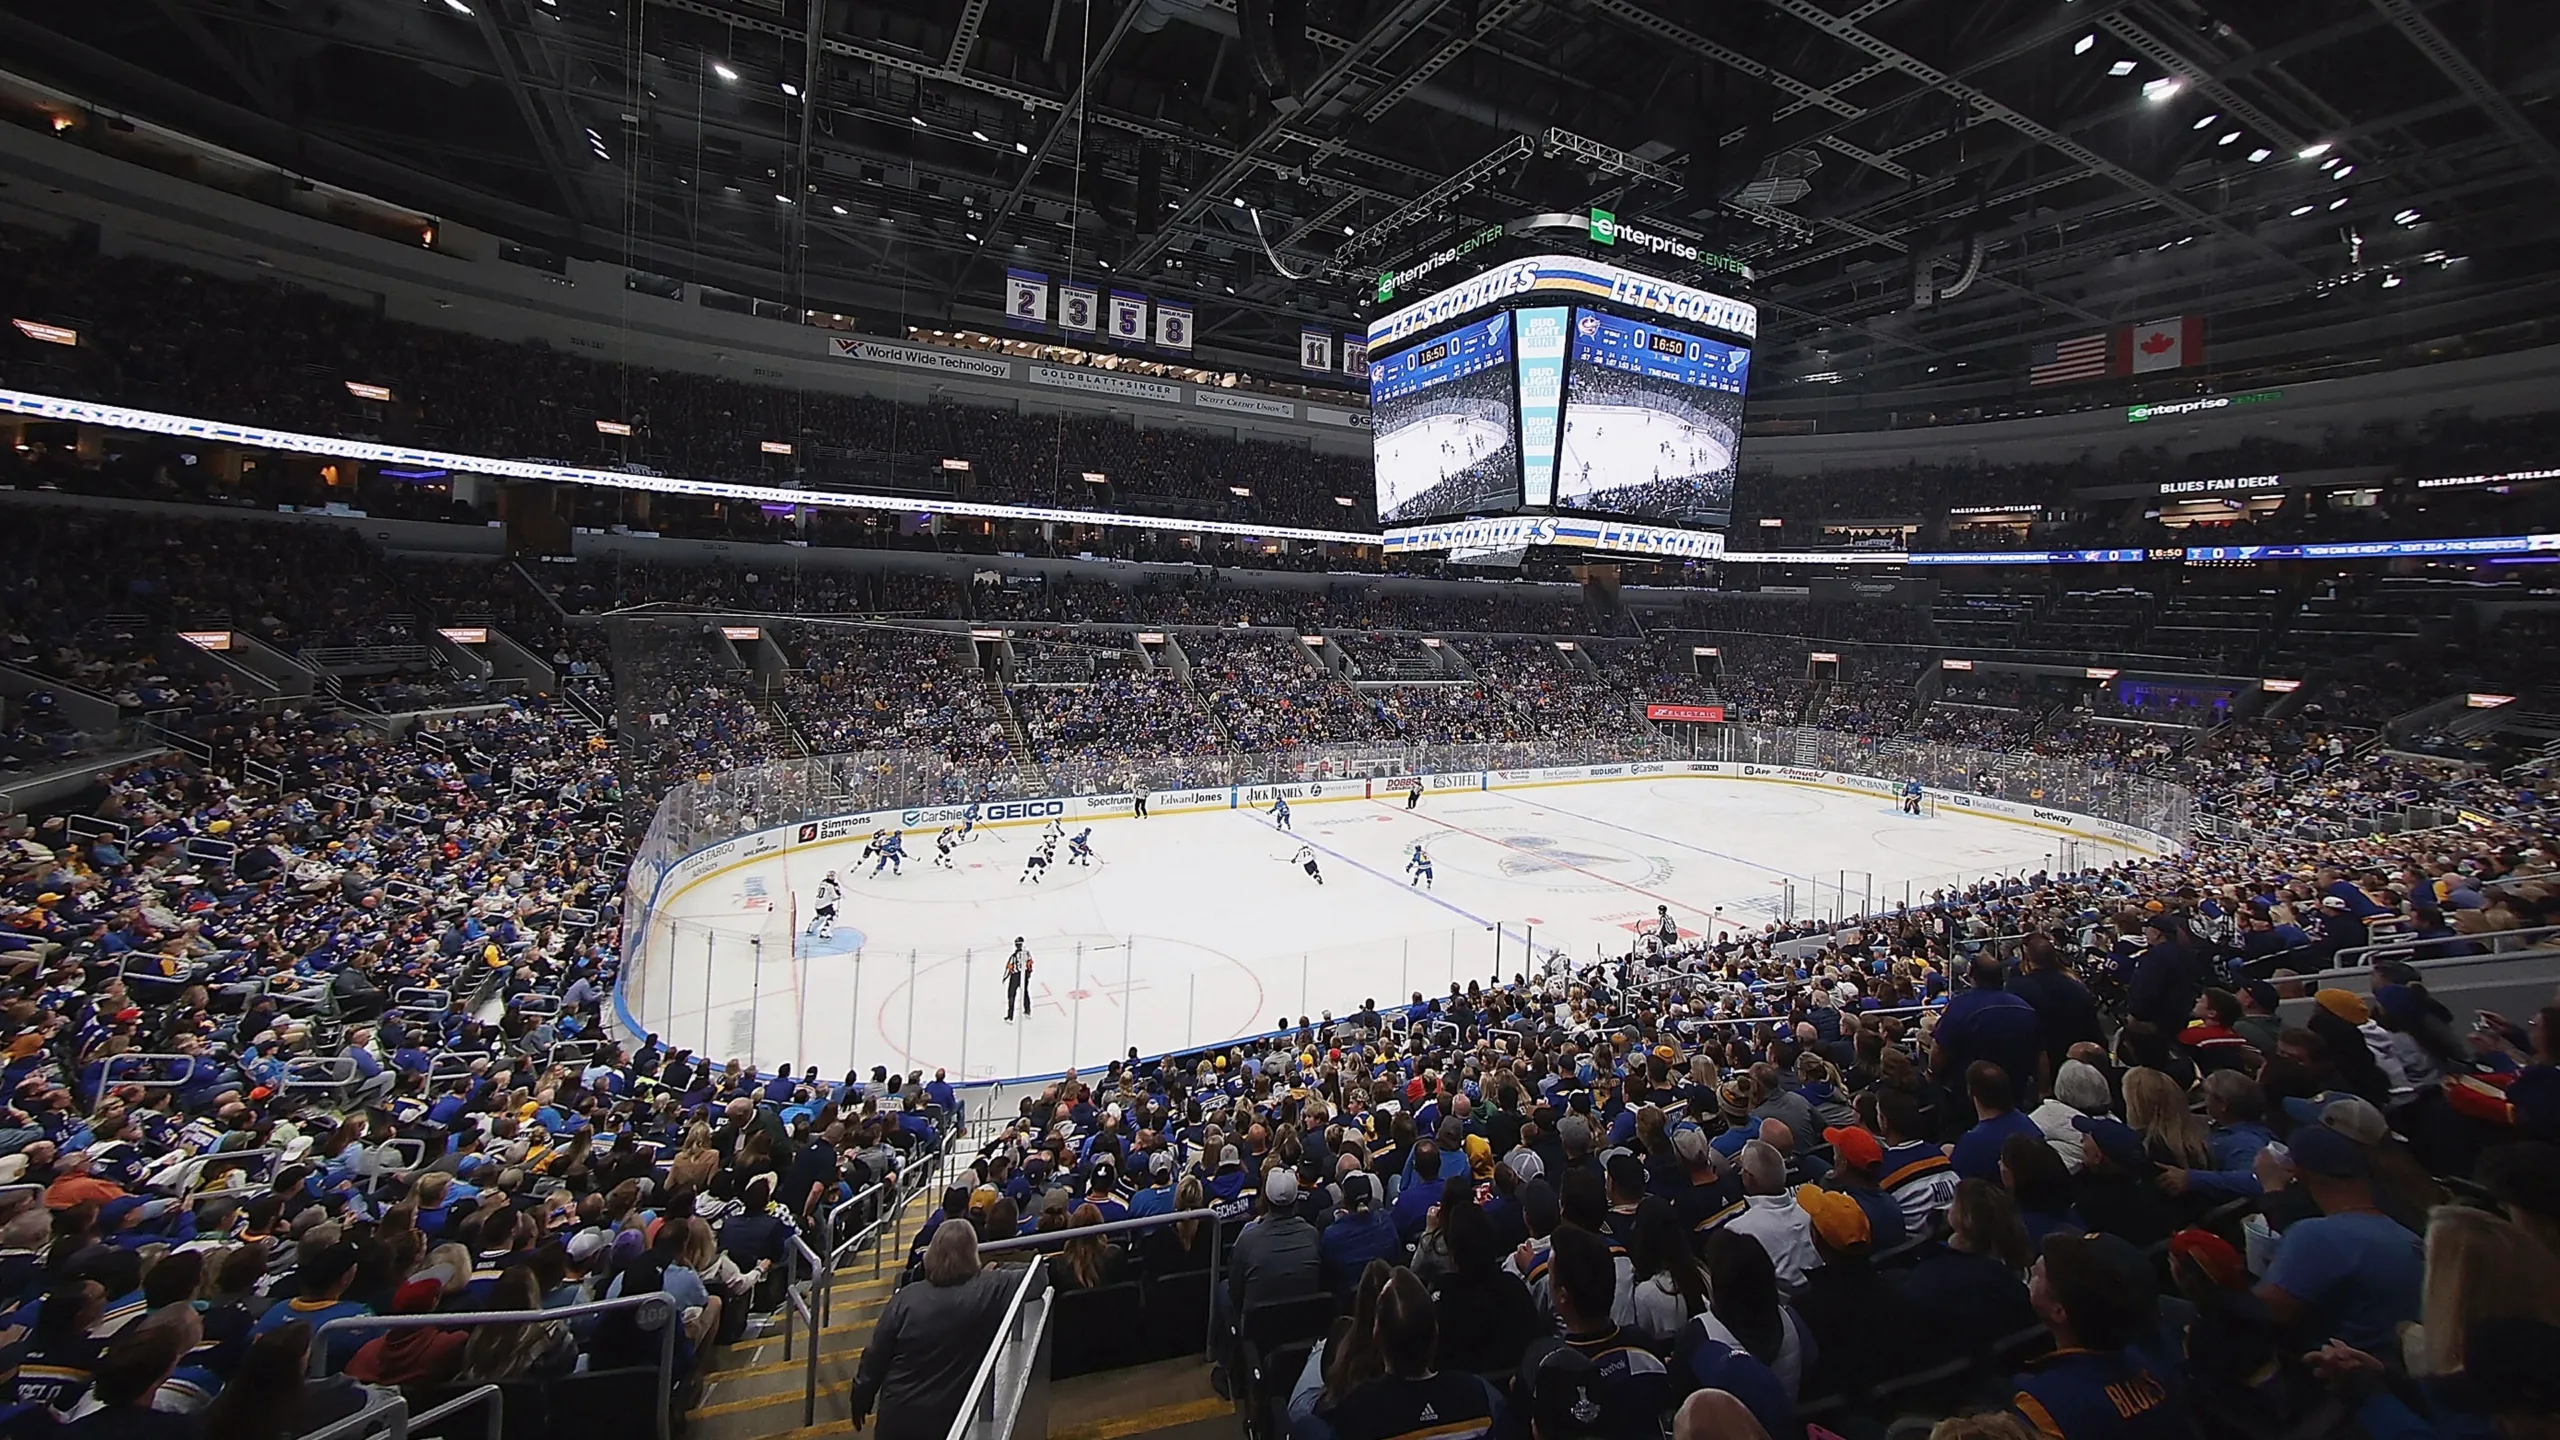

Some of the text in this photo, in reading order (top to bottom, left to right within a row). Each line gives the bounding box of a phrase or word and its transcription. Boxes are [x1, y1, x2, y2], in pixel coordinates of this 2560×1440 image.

[1590, 218, 1745, 273] enterprise CENTER
[1379, 224, 1502, 294] enterprise CENTER
[1018, 289, 1035, 316] 2
[1389, 262, 1540, 343] LET'S GO BLUES
[1608, 273, 1757, 340] LET'S GO BLUE
[1068, 298, 1088, 326] 3
[1119, 307, 1137, 335] 5
[1529, 317, 1555, 327] BUD
[1165, 317, 1184, 344] 8
[1524, 326, 1560, 337] LIGHT
[1527, 337, 1557, 348] SELTZER
[1634, 329, 1700, 361] 0 16:50 0
[866, 344, 1007, 376] World Wide Technology
[1306, 341, 1326, 367] 11
[1407, 337, 1460, 371] 0 16:50 0
[1346, 350, 1369, 375] 16
[1528, 367, 1555, 377] BUD
[1648, 368, 1661, 376] TIME
[1523, 376, 1559, 387] LIGHT
[1526, 386, 1556, 397] SELTZER
[2128, 392, 2282, 418] enterprise CENTER
[1527, 416, 1553, 426] BUD
[2161, 475, 2280, 494] BLUES FAN DECK
[2418, 469, 2560, 488] BALLPARK VILLAG
[1527, 483, 1549, 495] ELTZE
[1950, 506, 1991, 514] BALLPARK
[1402, 527, 1448, 552] LET'S
[1450, 522, 1476, 549] GO
[1477, 517, 1559, 547] BLUES
[1595, 522, 1658, 553] LET'S
[1661, 531, 1690, 556] GO
[1690, 533, 1725, 559] BLU
[2108, 547, 2224, 562] 0 16:50 0
[1143, 571, 1182, 582] TOGETHER
[1668, 710, 1717, 718] ELECTRIC
[1590, 767, 1622, 776] BUD LIGHT
[1639, 763, 1664, 773] CarShield
[1777, 767, 1828, 779] Schnucks
[1387, 777, 1417, 787] DOBBS
[1446, 775, 1479, 788] STIFEL
[1789, 775, 1818, 783] REWARDS
[1161, 792, 1223, 805] Edward Jones
[1246, 788, 1269, 801] JACK
[1087, 796, 1133, 809] Spectrum
[1972, 800, 2016, 814] HealthCare
[921, 809, 966, 823] CarShiel
[987, 801, 1064, 820] GEICO
[2033, 808, 2073, 826] betway
[821, 815, 871, 830] Simmons
[2096, 818, 2126, 831] WELLS
[820, 828, 848, 839] Bank
[681, 842, 736, 873] WELLS FARGO
[692, 861, 718, 880] Advisors
[2105, 957, 2119, 970] 10
[1215, 1198, 1250, 1218] SCHENN
[2104, 1374, 2166, 1419] BLUES
[1419, 1412, 1439, 1421] adidas
